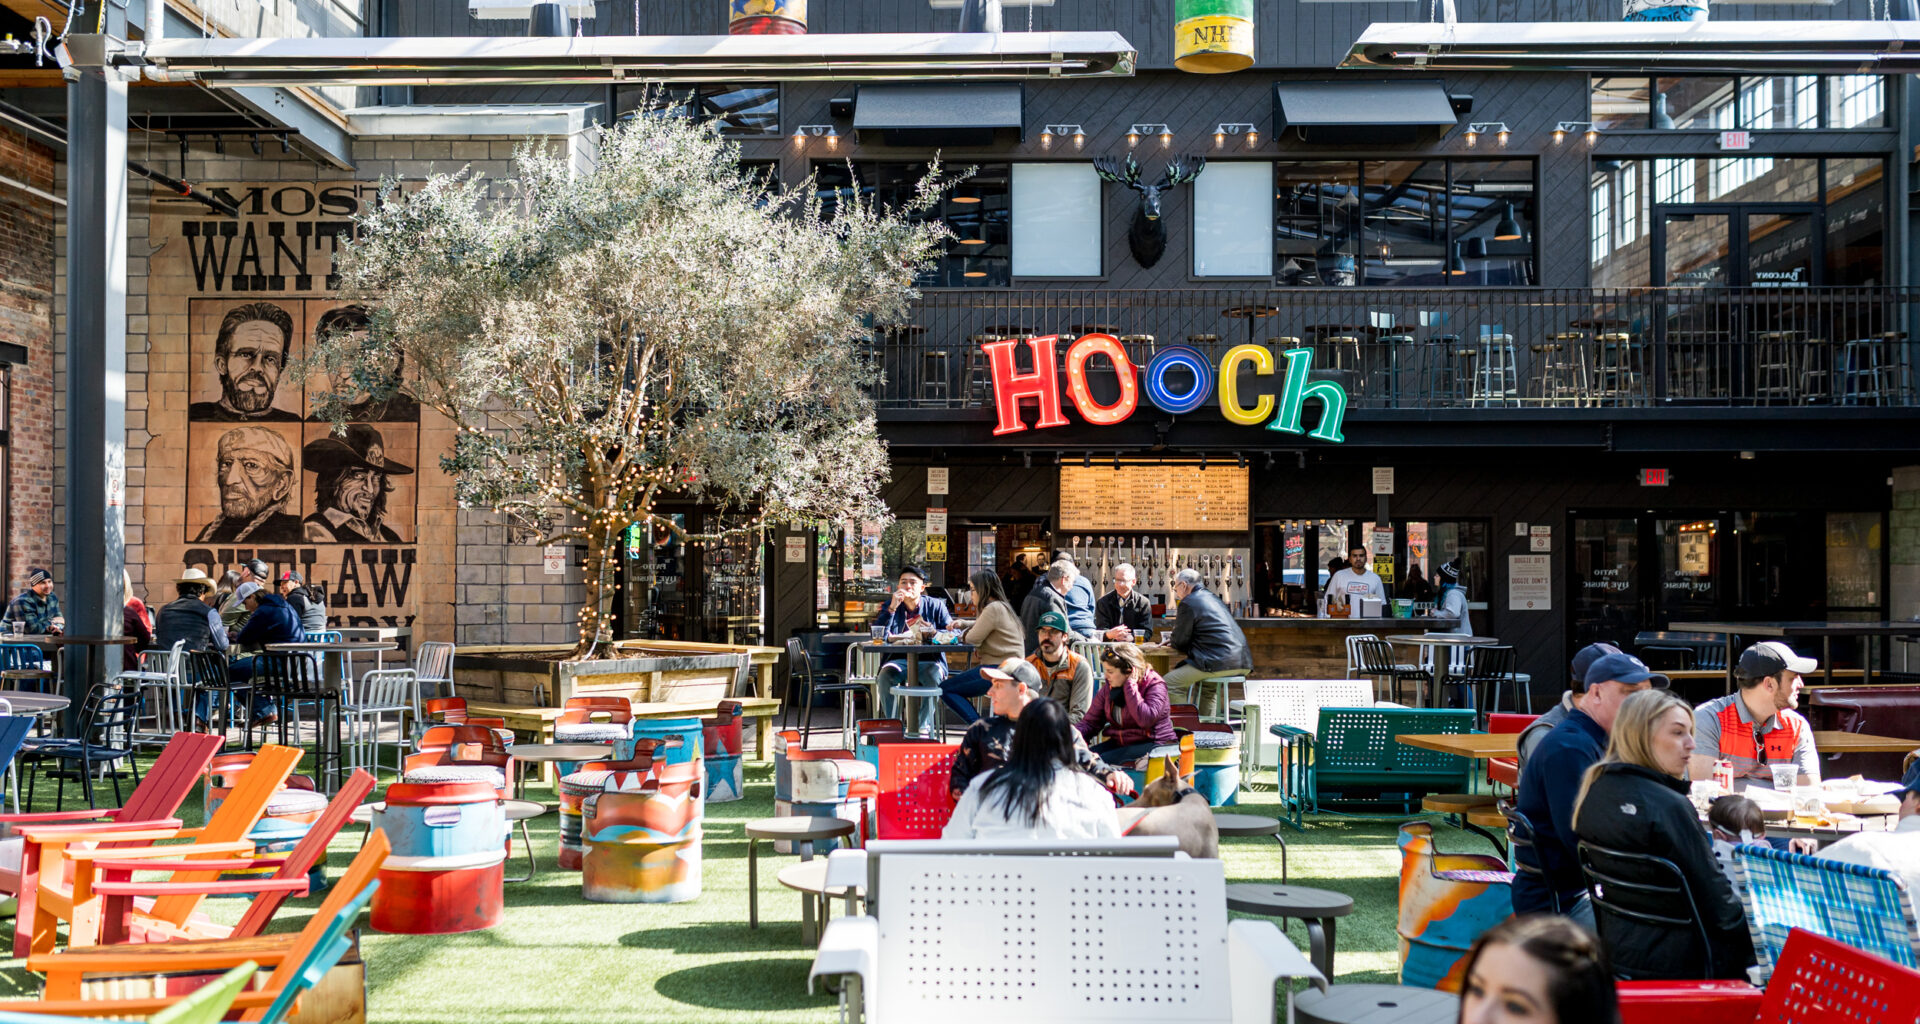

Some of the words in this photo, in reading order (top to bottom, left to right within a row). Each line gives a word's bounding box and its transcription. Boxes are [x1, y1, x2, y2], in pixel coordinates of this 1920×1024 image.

[1727, 132, 1746, 148] EXIT
[206, 185, 402, 216] MOST
[182, 221, 363, 291] WANT
[1646, 468, 1666, 485] EXIT
